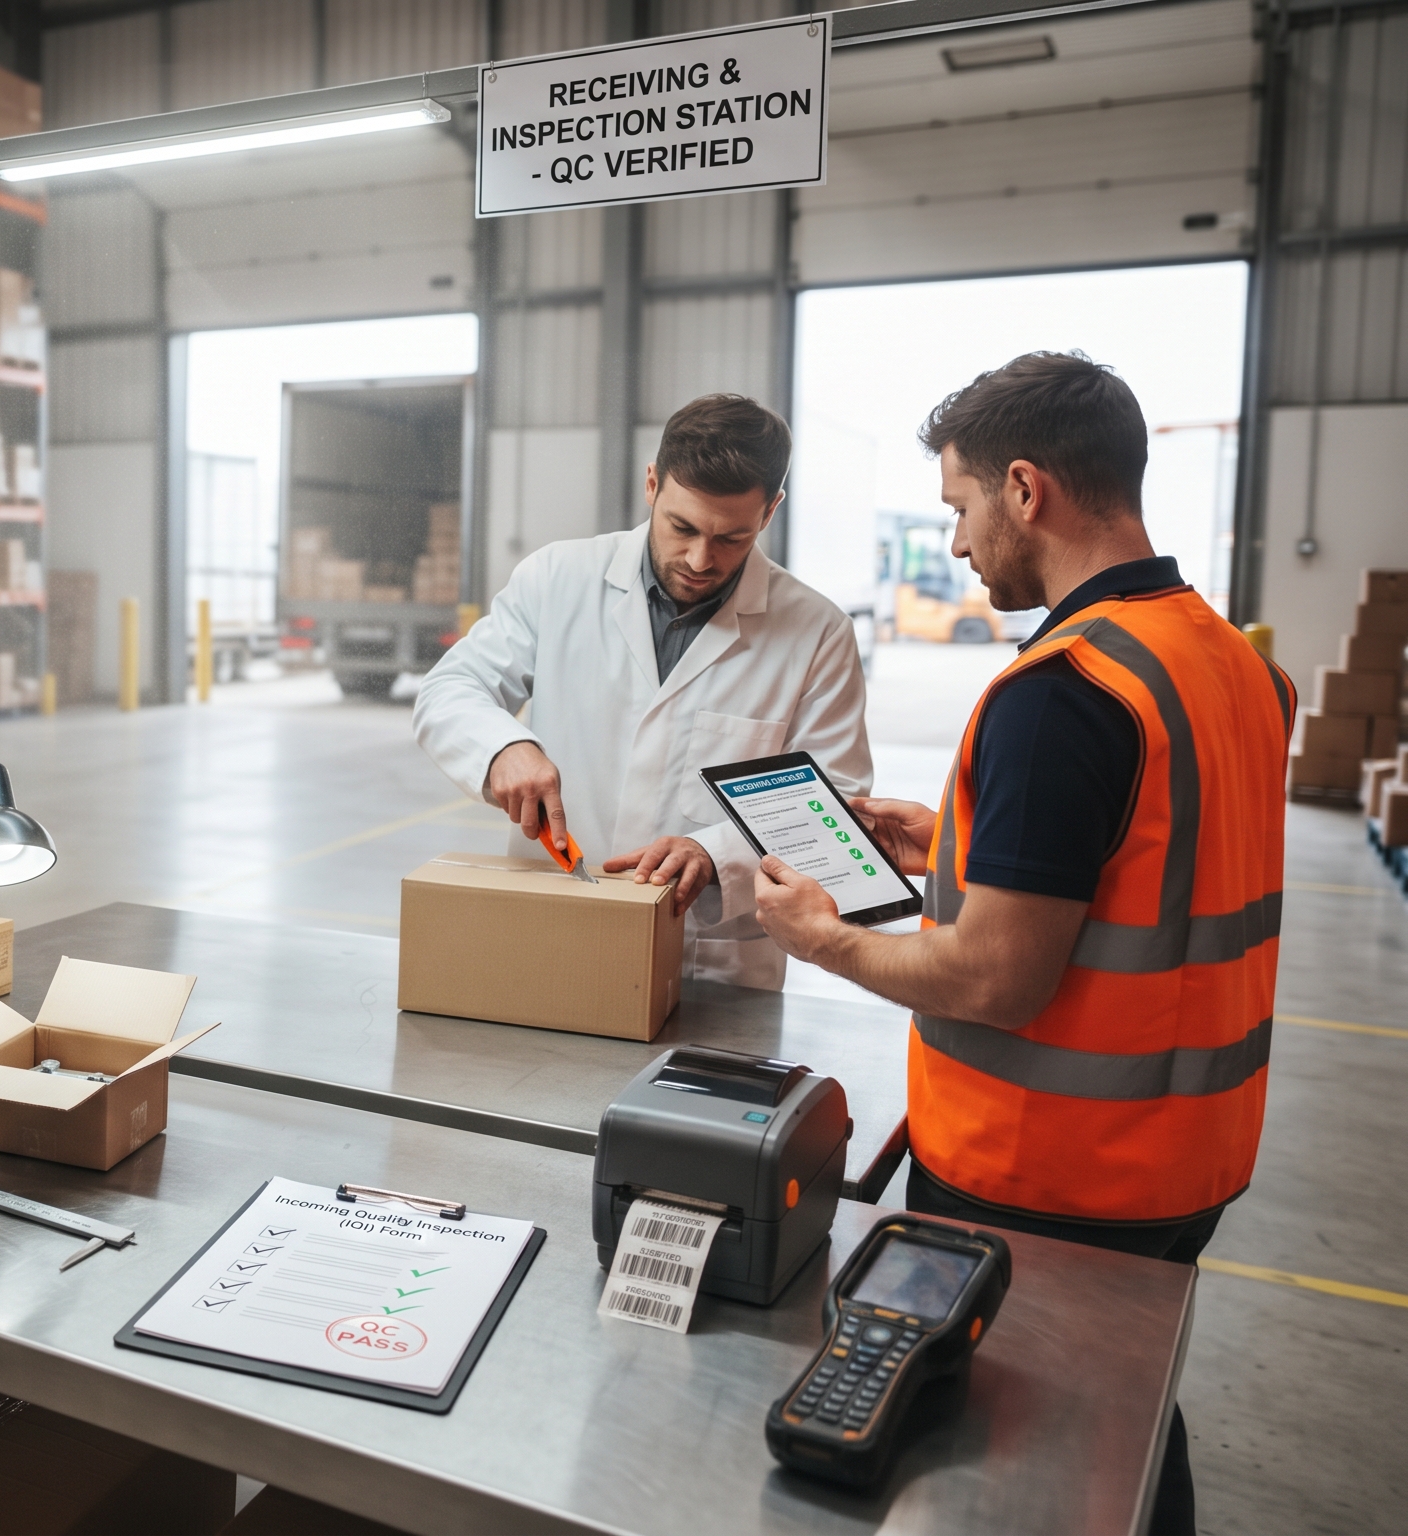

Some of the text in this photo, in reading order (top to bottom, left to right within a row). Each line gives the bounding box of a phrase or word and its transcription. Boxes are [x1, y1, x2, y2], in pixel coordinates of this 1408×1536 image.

[549, 57, 741, 108] RECEIVING &
[492, 88, 812, 152] INSPECTION STATION
[550, 153, 594, 184] QC
[604, 136, 754, 178] VERIFIED
[275, 1195, 350, 1216] Incoming
[416, 1220, 506, 1243] Inspection
[379, 1225, 423, 1241] Form
[337, 1331, 409, 1353] PASS
[360, 1321, 400, 1336] QC
